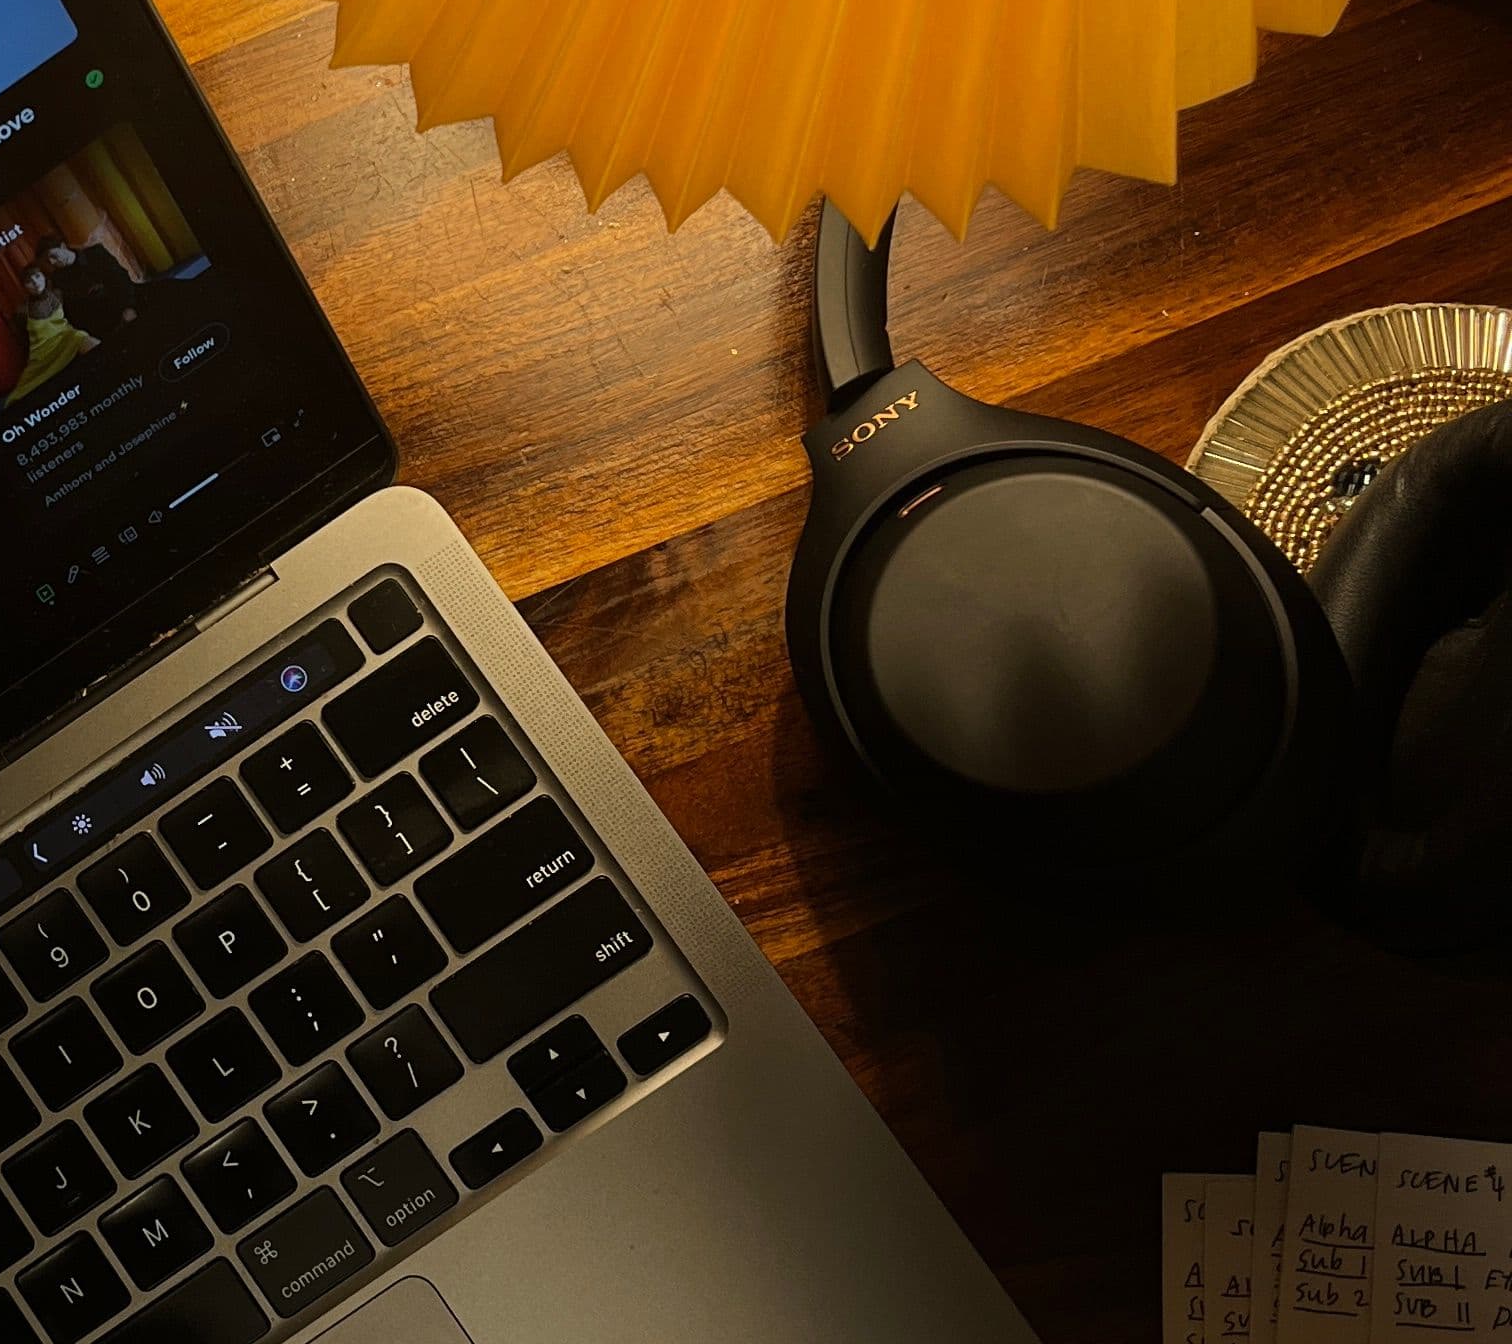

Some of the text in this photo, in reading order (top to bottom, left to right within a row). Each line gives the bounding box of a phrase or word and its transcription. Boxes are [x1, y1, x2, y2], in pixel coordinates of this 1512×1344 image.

[173, 336, 215, 370] Follow
[1, 384, 81, 443] Oh Wonder
[89, 374, 143, 417] monthly
[831, 390, 919, 462] SONY
[25, 440, 85, 484] listeners
[410, 690, 460, 728] delete
[525, 849, 576, 888] return
[594, 930, 634, 962] shift
[57, 1044, 72, 1064] I
[136, 986, 158, 1009] O
[217, 929, 236, 954] P
[1397, 1169, 1478, 1195] SCENE
[385, 1188, 436, 1227] option
[1298, 1213, 1368, 1243] Alpha
[1391, 1224, 1477, 1253] ALPHA
[281, 1239, 356, 1298] command
[1296, 1247, 1343, 1272] Sub
[1395, 1259, 1443, 1283] SUB
[1295, 1283, 1369, 1307] Sub 2
[1393, 1293, 1437, 1317] SUB
